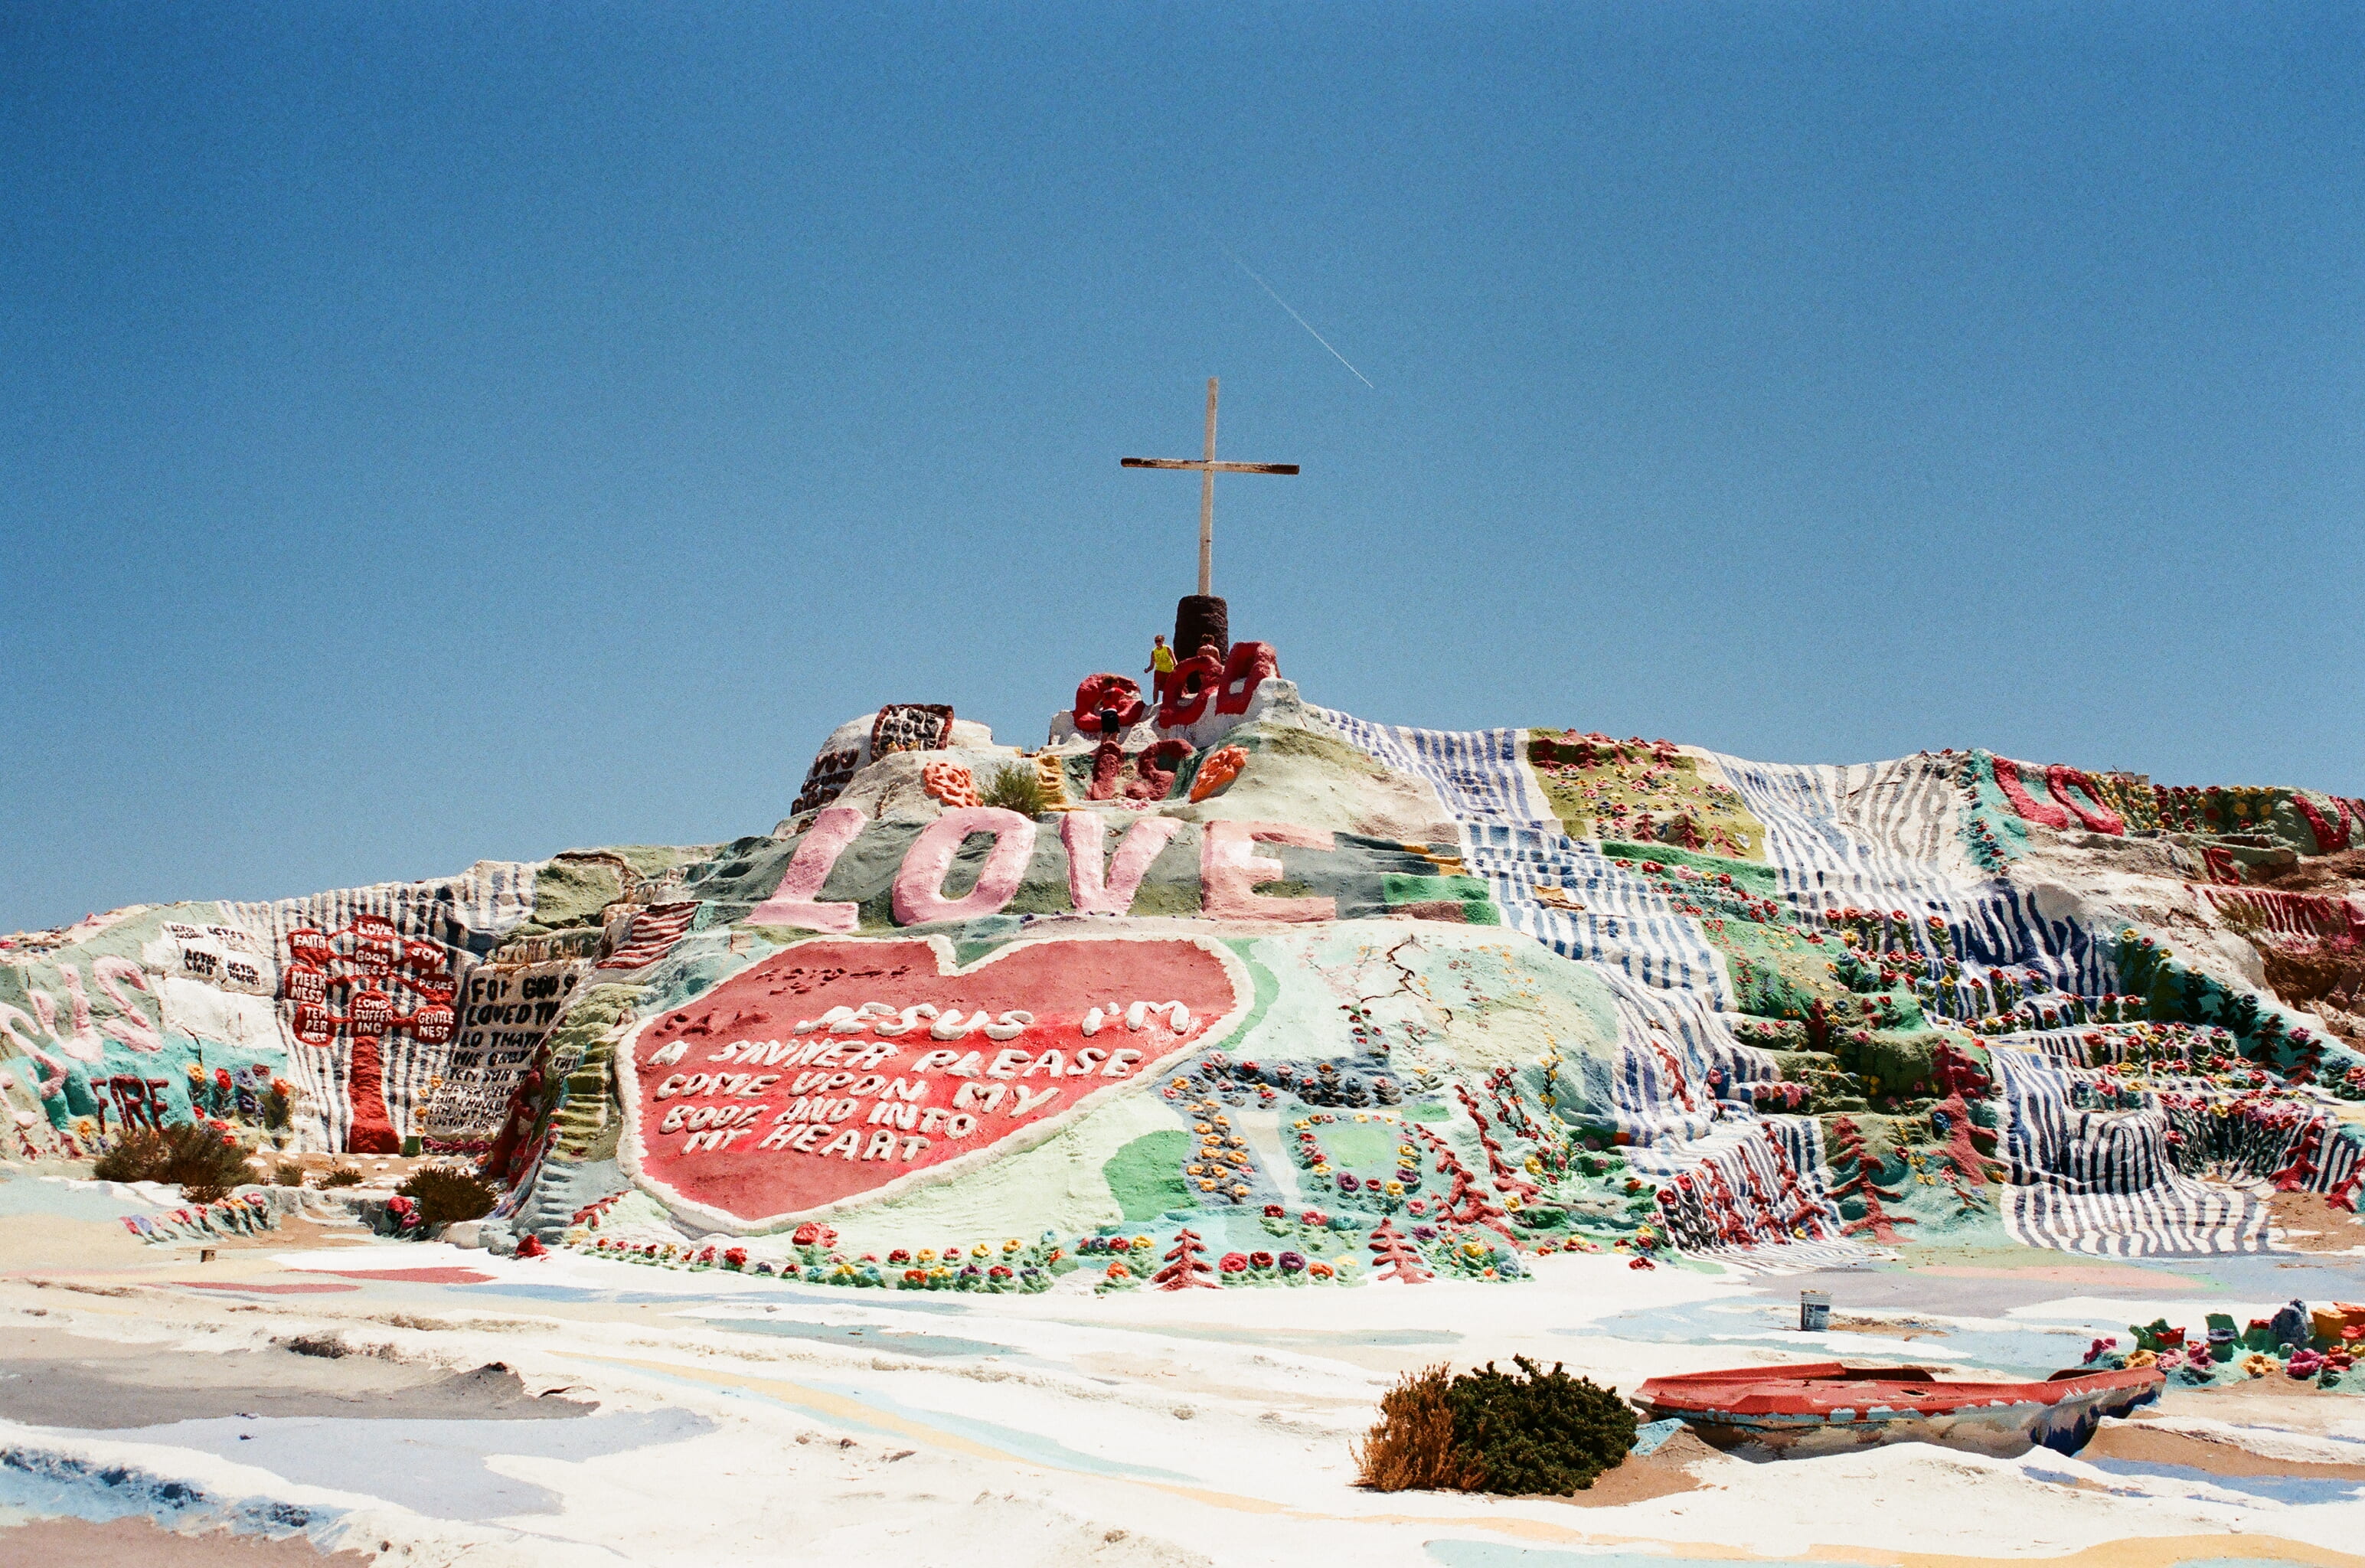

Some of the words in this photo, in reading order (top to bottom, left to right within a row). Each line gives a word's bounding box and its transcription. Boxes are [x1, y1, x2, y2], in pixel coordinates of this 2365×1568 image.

[1073, 636, 1281, 733] GOD
[883, 718, 939, 739] HOLY
[1084, 739, 1193, 801] IS
[747, 806, 1337, 933] LOVE
[2201, 848, 2240, 886] IS
[358, 921, 394, 936] LOVE
[293, 934, 326, 949] FAITH
[355, 949, 389, 963] GOOD
[411, 947, 444, 965] JOY
[354, 963, 389, 976] NESS
[291, 970, 326, 989] MEEK
[419, 978, 455, 991] PEACE
[522, 975, 559, 1000] GOD
[290, 985, 322, 1003] NESS
[305, 1006, 328, 1019] TEM
[355, 998, 390, 1009] LONG
[354, 1008, 394, 1021] SUFFER
[417, 1010, 455, 1025] GENTLE
[465, 1003, 531, 1027] LOVED
[535, 1001, 561, 1026] TH
[793, 1001, 1034, 1041] JESUS
[1082, 1000, 1190, 1037] I'M
[306, 1020, 328, 1032] PER
[358, 1021, 383, 1034] ING
[417, 1025, 450, 1041] NESS
[647, 1040, 689, 1067] A
[707, 1038, 899, 1071] SINNER
[910, 1047, 1142, 1079] PLEASE
[656, 1073, 782, 1100] COME
[789, 1071, 927, 1102] UPON
[952, 1082, 1060, 1118] MY
[90, 1073, 169, 1135] FIRE
[772, 1096, 859, 1125] AND
[867, 1102, 978, 1139] INTO
[681, 1129, 753, 1155] MY
[757, 1123, 932, 1161] HEART
